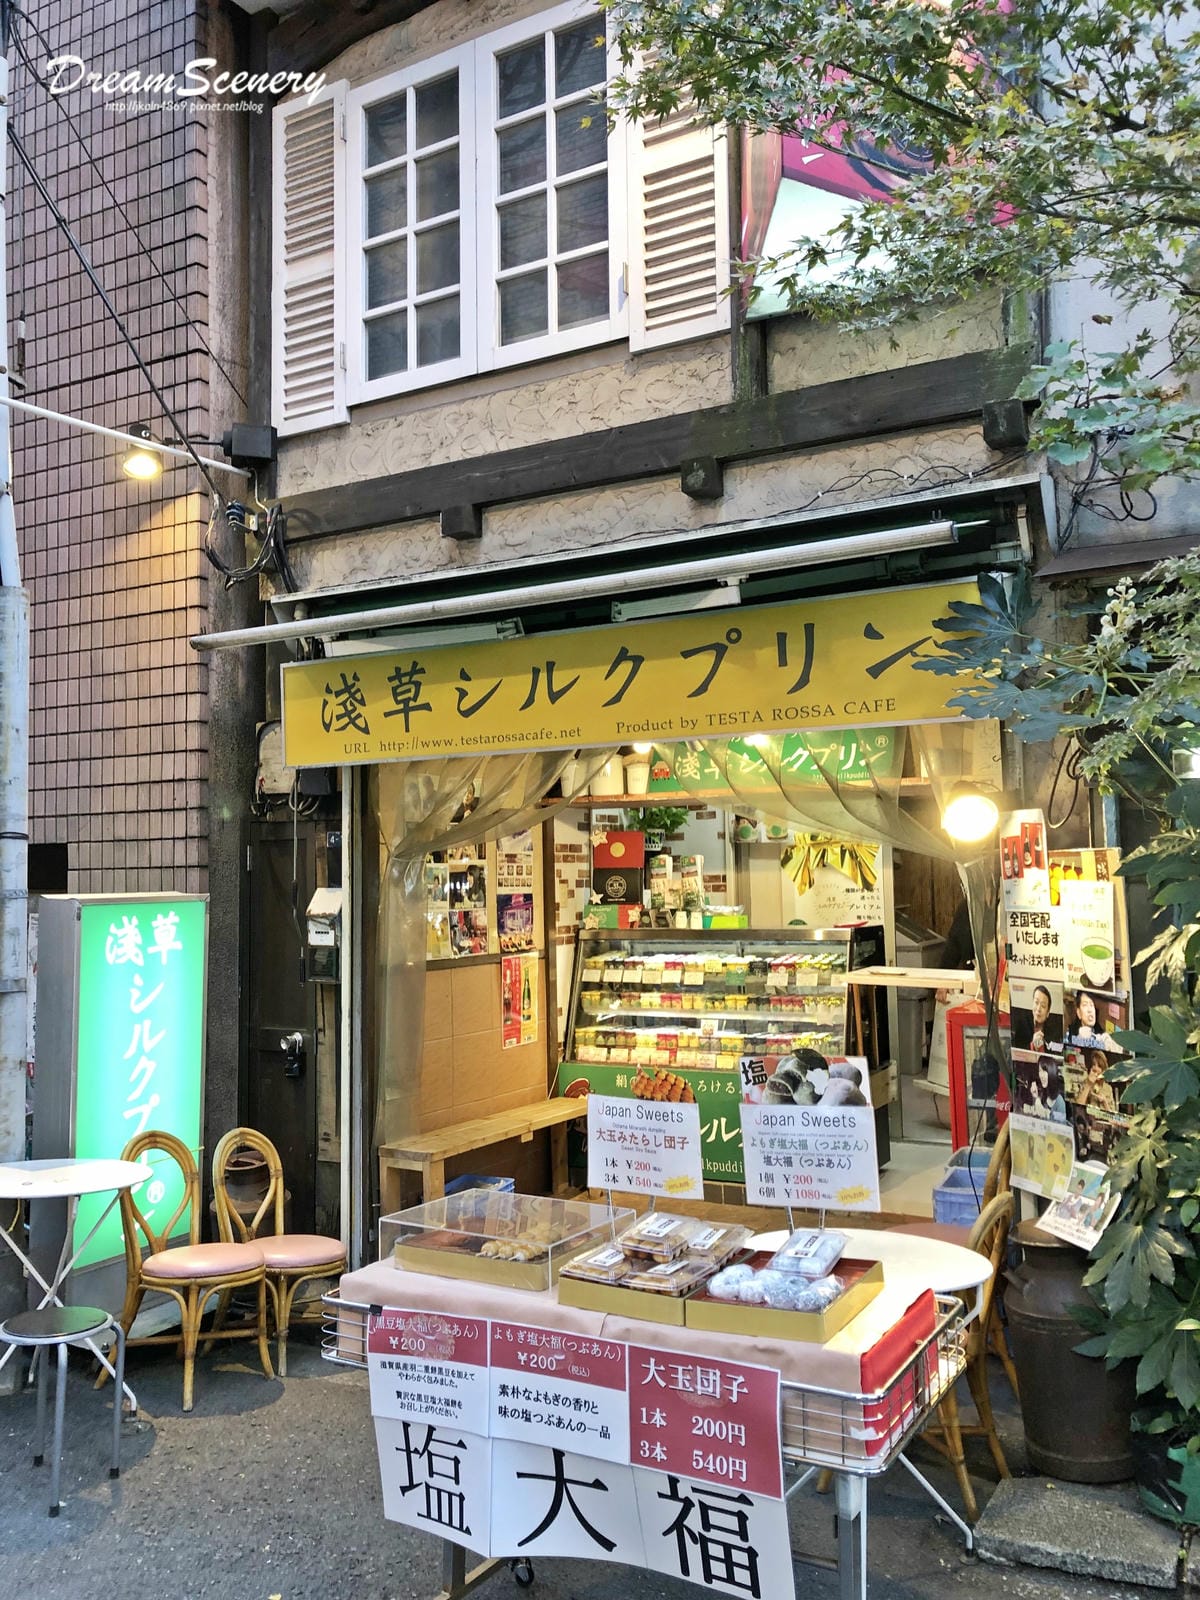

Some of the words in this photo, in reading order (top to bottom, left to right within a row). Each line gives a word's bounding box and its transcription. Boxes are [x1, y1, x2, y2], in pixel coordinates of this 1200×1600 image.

[344, 742, 370, 754] URL
[616, 718, 673, 734] Product
[681, 715, 698, 730] by
[705, 710, 763, 727] TESTA
[772, 703, 835, 721] ROSSA
[844, 698, 896, 715] CAFE
[1010, 911, 1050, 928] 全国宅配
[1016, 930, 1059, 946] いたします
[741, 1059, 768, 1086] 塩
[597, 1102, 631, 1119] Japan
[636, 1104, 684, 1123] Sweets
[755, 1111, 794, 1128] Japan
[801, 1111, 857, 1128] Sweets
[596, 1128, 690, 1150] 大玉みたらし団子
[604, 1157, 619, 1168] 1本
[604, 1173, 619, 1184] 3本
[759, 1172, 774, 1184] 1個
[759, 1187, 776, 1199] 6個
[389, 1336, 426, 1352] ¥200
[494, 1327, 621, 1361] よもぎ塩大福(つぶあん)
[518, 1351, 556, 1371] ¥200
[641, 1357, 749, 1403] 大玉団子
[498, 1384, 600, 1415] 素朴なよもぎの香りと
[498, 1405, 611, 1440] 味の塩つぶあんの一品
[640, 1407, 667, 1428] 1本
[691, 1415, 746, 1447] 200円
[640, 1440, 667, 1462] 3本
[692, 1449, 747, 1482] 540円
[395, 1421, 762, 1599] 塩大福
